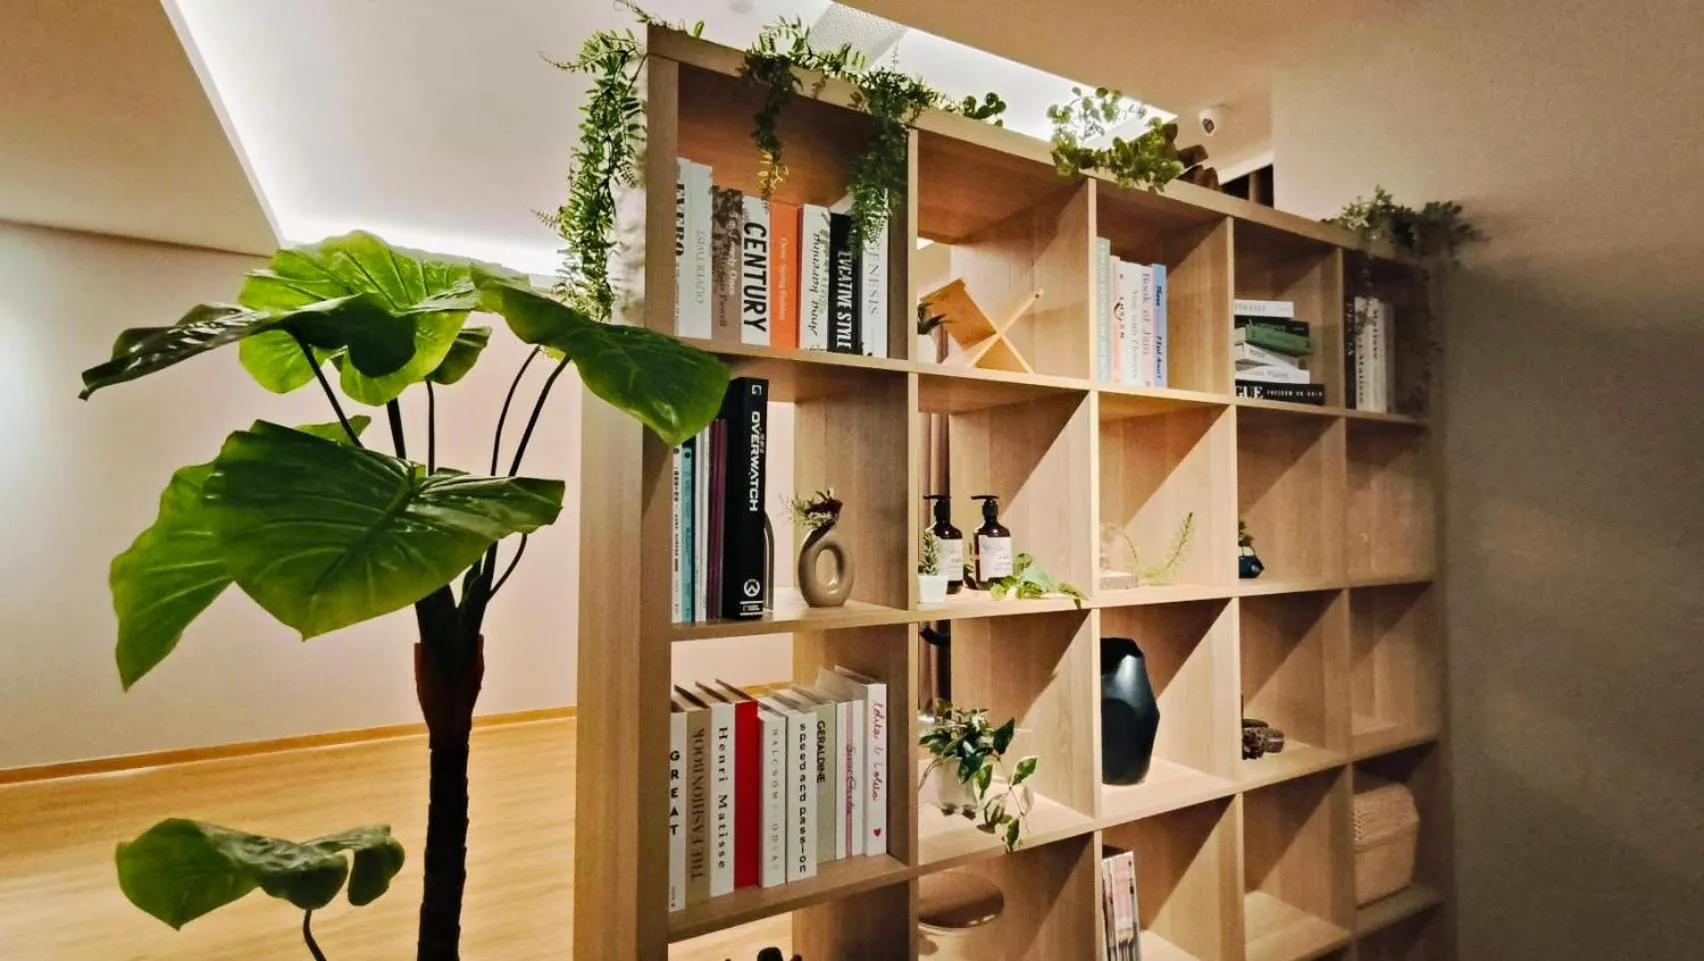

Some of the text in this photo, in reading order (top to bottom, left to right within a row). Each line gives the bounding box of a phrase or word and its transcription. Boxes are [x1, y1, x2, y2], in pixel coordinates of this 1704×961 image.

[743, 222, 767, 333] CENTURY
[807, 299, 819, 336] Anna
[836, 312, 852, 349] STYLE
[749, 411, 761, 512] OVERWATCH
[669, 750, 681, 836] GREAT
[718, 727, 728, 869] Henri Matisse
[799, 722, 807, 873] speed and passion
[817, 720, 826, 784] GERALDINE
